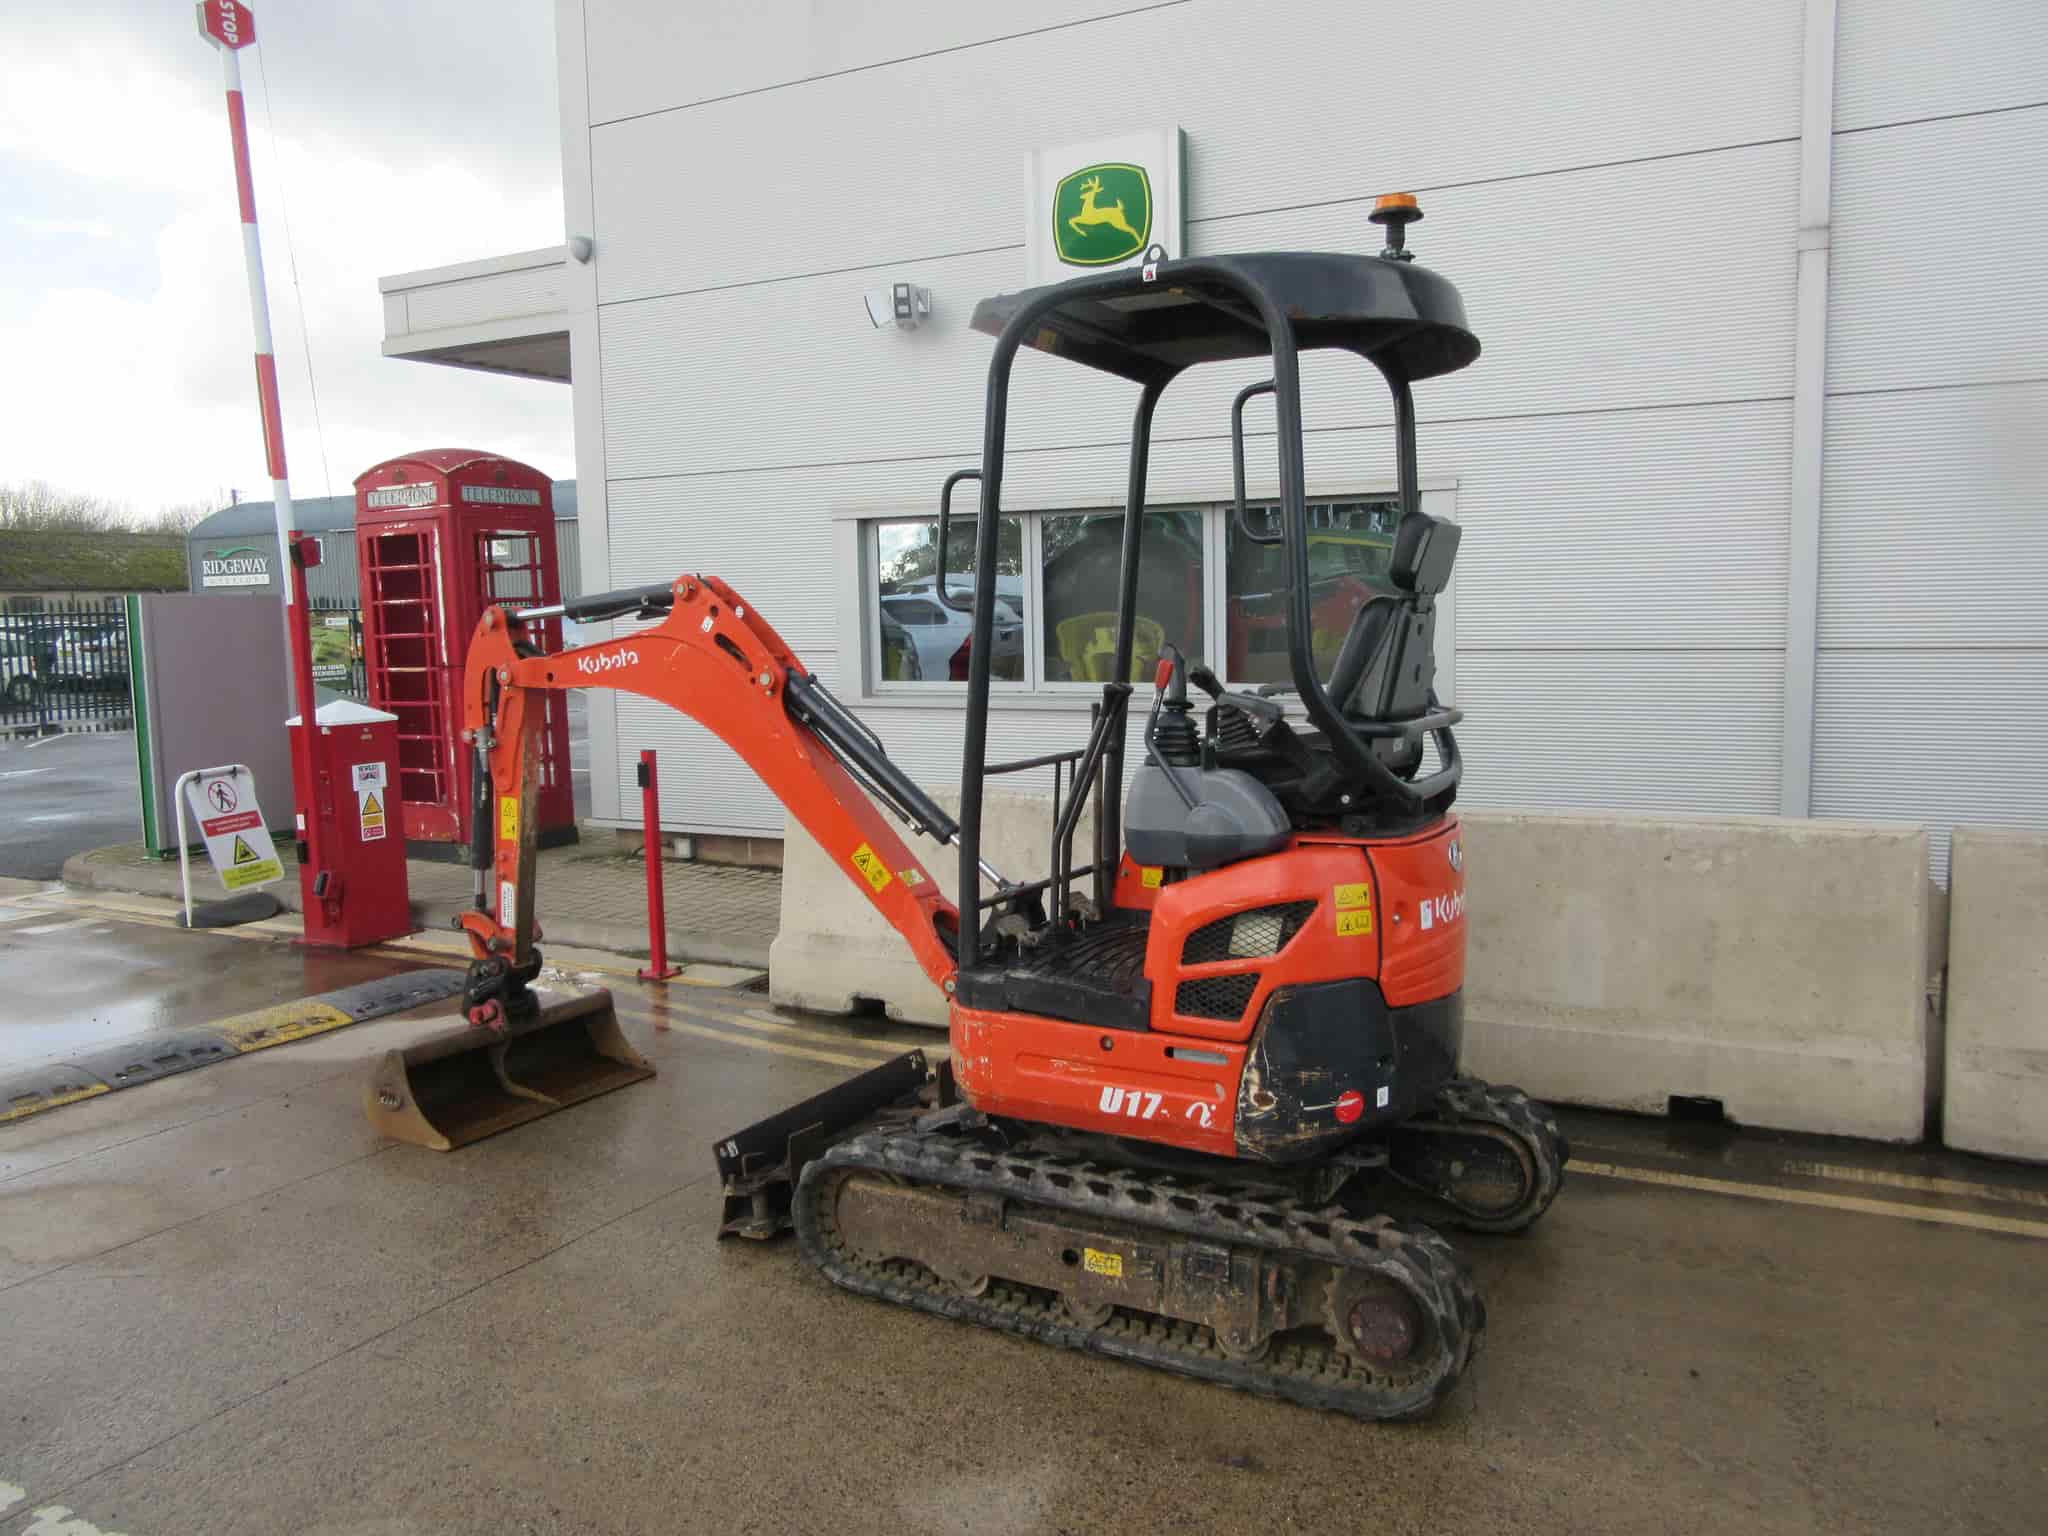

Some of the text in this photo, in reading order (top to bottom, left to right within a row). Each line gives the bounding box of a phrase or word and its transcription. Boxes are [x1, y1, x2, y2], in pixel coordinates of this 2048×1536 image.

[220, 0, 239, 43] STOP
[202, 558, 267, 574] RIDGEWAY
[577, 648, 639, 674] Kubota
